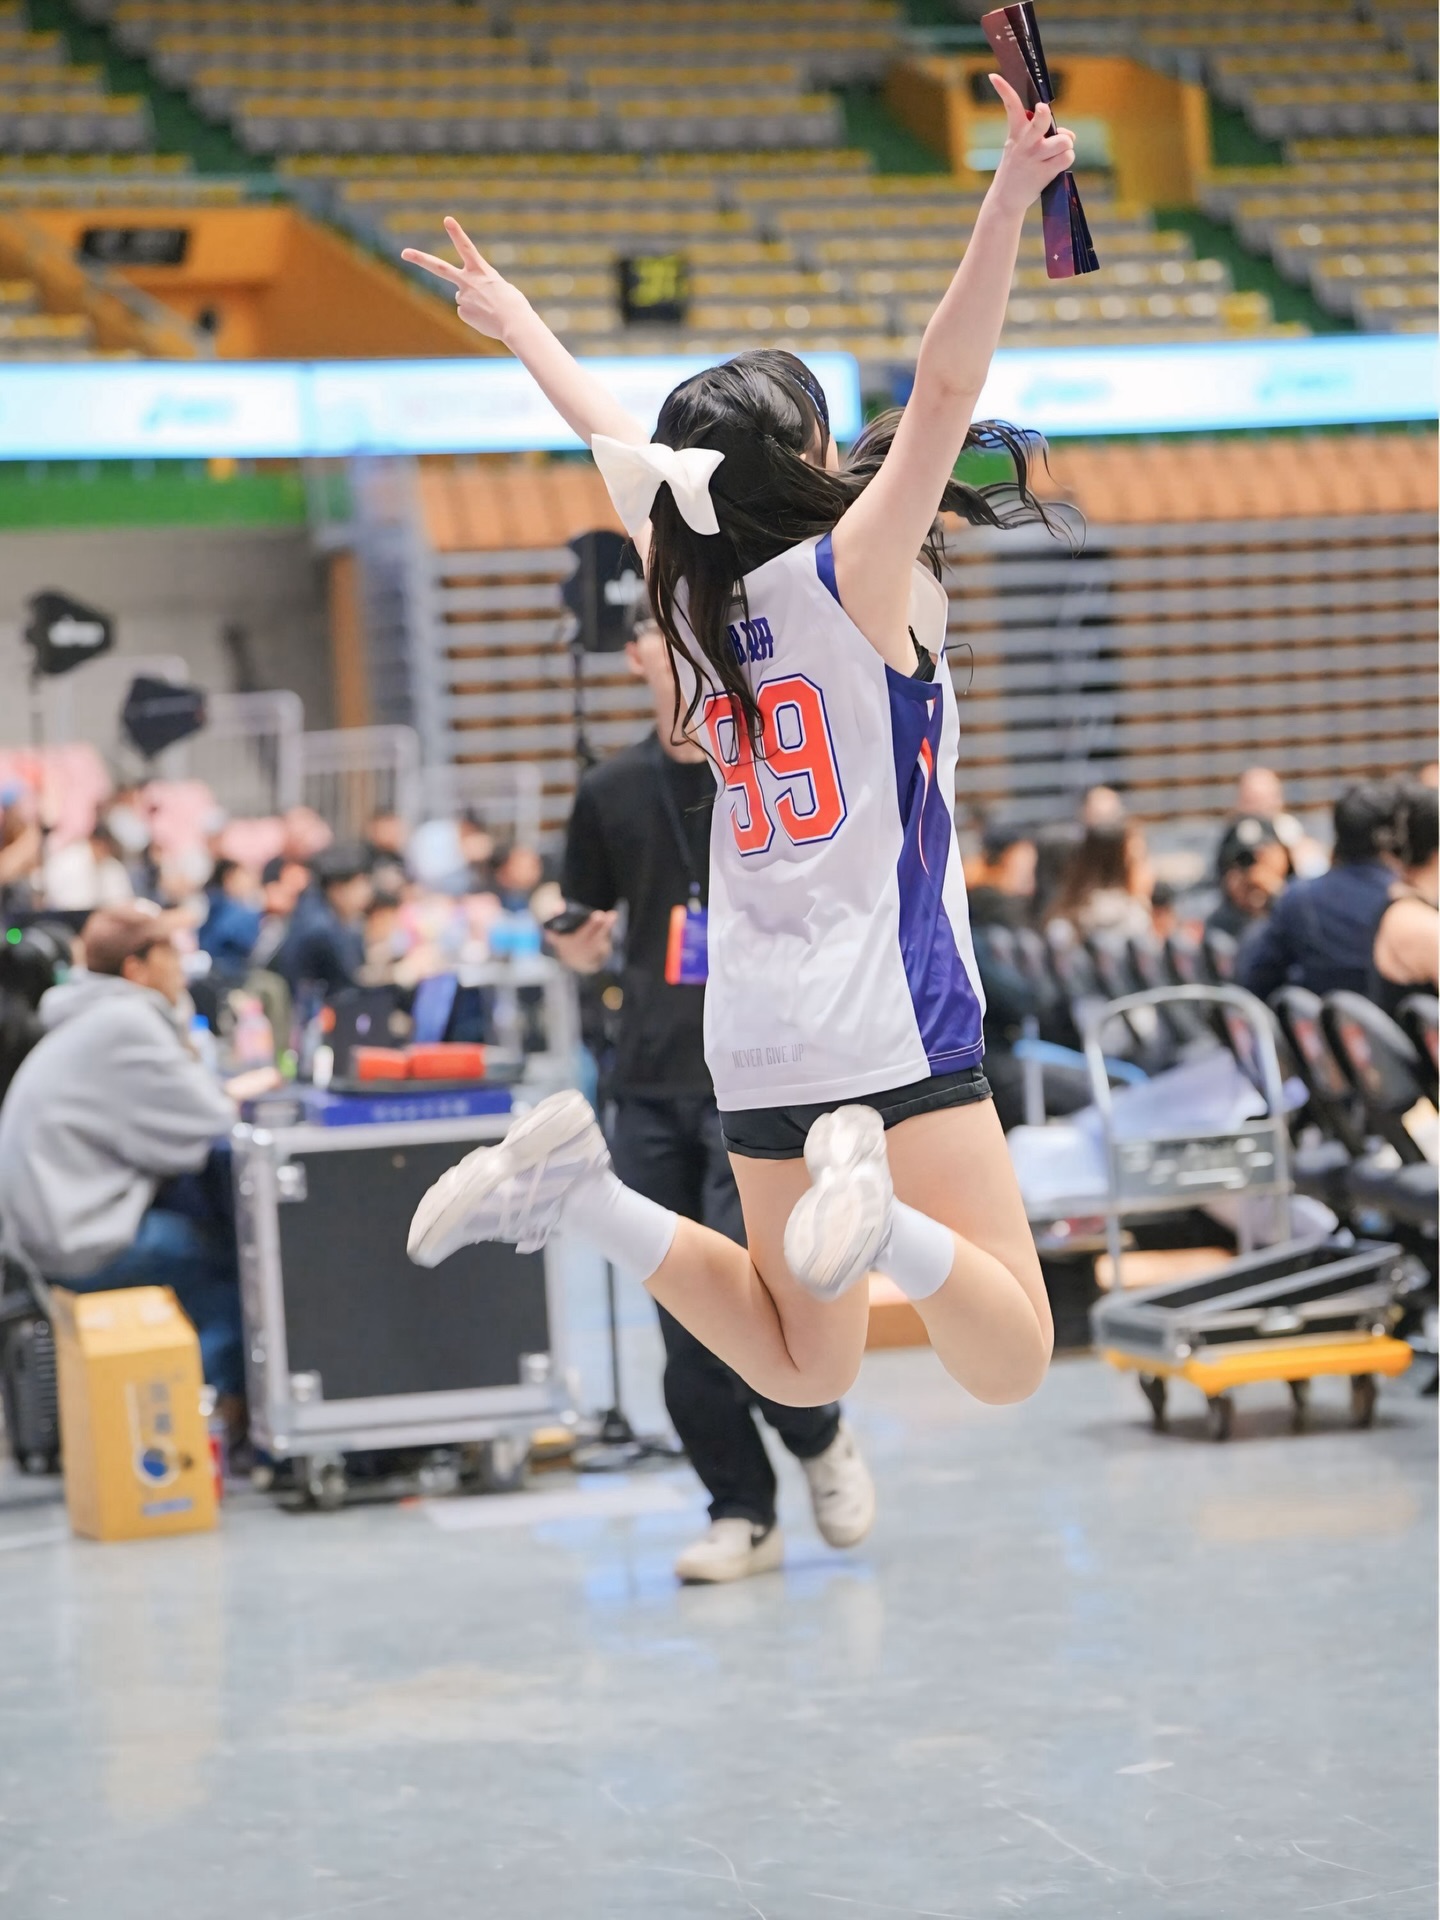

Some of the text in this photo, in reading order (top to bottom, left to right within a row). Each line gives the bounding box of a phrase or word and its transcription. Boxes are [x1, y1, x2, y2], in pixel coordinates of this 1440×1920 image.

[702, 672, 848, 858] 99
[731, 1043, 805, 1069] NEVER GIVE UP
